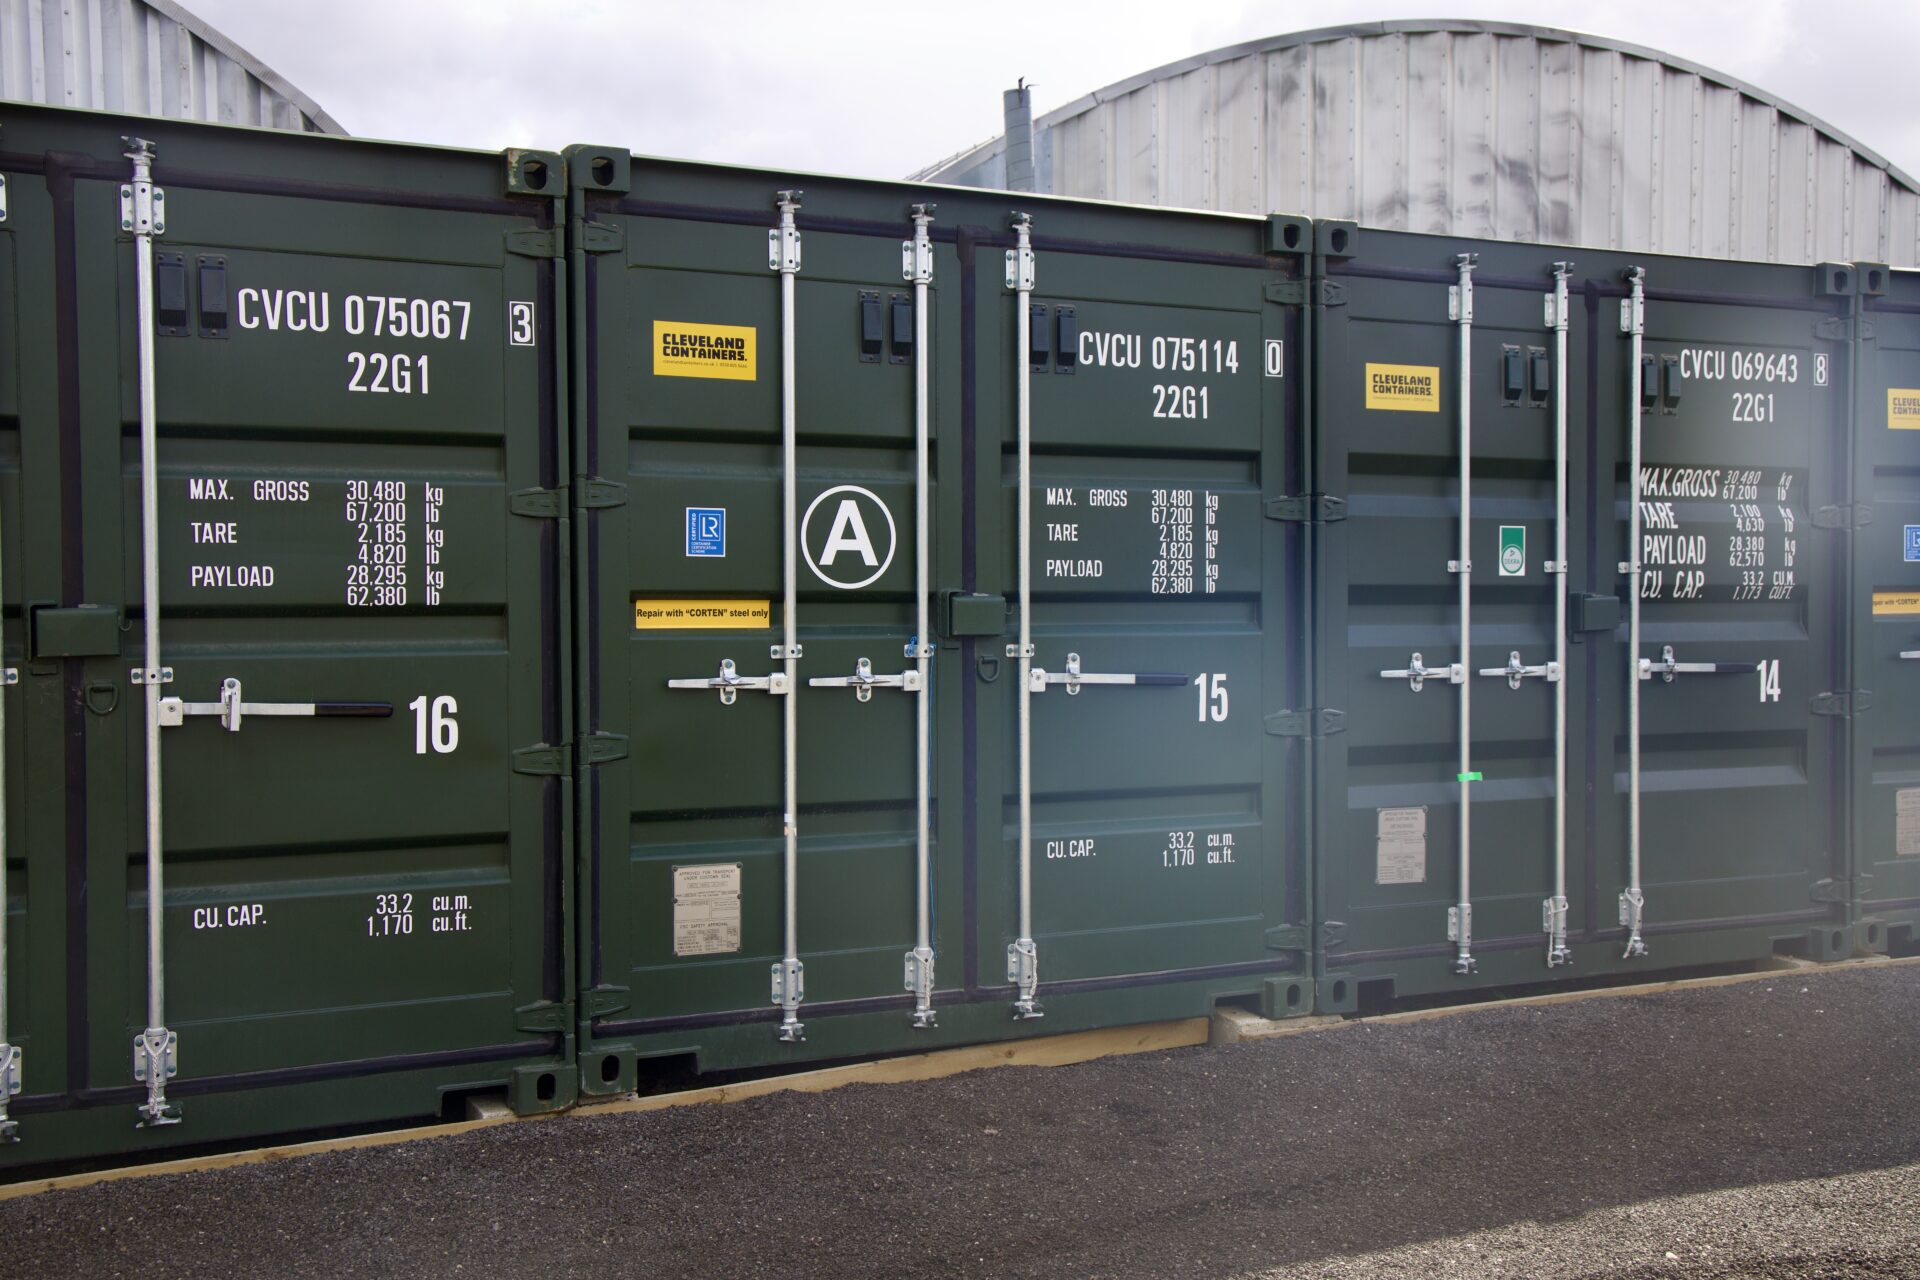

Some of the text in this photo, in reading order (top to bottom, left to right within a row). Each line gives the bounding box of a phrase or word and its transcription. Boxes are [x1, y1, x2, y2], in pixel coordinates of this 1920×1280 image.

[238, 287, 531, 344] CVCU 075067 3
[663, 333, 745, 350] CLEVELAND
[663, 346, 748, 361] CONTAINERS.
[1079, 331, 1282, 376] CVCU 075114 0
[347, 351, 429, 394] 22G1
[1680, 348, 1827, 383] CVCU 069643 8
[1373, 374, 1431, 386] CLEVELAND
[1152, 384, 1208, 419] 22G1
[1732, 392, 1774, 423] 22G1
[189, 478, 444, 507] MAX. GROSS 30,480 kg
[1778, 471, 1793, 490] kg
[1046, 487, 1219, 511] MAX. GROSS 30,480 kg
[1777, 486, 1787, 501] lb
[345, 502, 440, 523] 67,200 lb
[1151, 506, 1218, 525] 67,200 lb
[1640, 501, 1679, 530] TARE
[1777, 505, 1794, 522] kg
[190, 522, 444, 549] TARE 2,185 kg
[816, 497, 882, 568] A
[1046, 523, 1219, 546] TARE 2,185 kg
[1783, 519, 1794, 533] lb
[357, 544, 440, 565] 4,820 lb
[1159, 541, 1218, 560] 4,820 lb
[1643, 534, 1706, 565] PAYLOAD
[1783, 536, 1797, 556] kg
[1783, 553, 1794, 567] lb
[191, 564, 444, 591] PAYLOAD 28,295 kg
[1046, 559, 1219, 581] PAYLOAD 28,295 kg
[347, 585, 440, 607] 62,380 lb
[1151, 576, 1218, 594] 62,380 lb
[1640, 570, 1795, 599] CU. CAP. 33.2 CU.M.
[1732, 585, 1762, 601] 1,173
[636, 608, 664, 619] Repair
[665, 608, 684, 618] with
[729, 608, 750, 618] steel
[751, 608, 769, 619] only
[1756, 659, 1781, 703] 14
[1194, 672, 1229, 722] 15
[409, 695, 459, 754] 16
[1047, 831, 1235, 859] CU. CAP. 33.2 cu.m.
[1162, 847, 1235, 867] 1,170 cu.ft.
[194, 893, 472, 930] CU. CAP. 33.2 cu.m.
[367, 911, 472, 937] 1,170 cu.ft.
